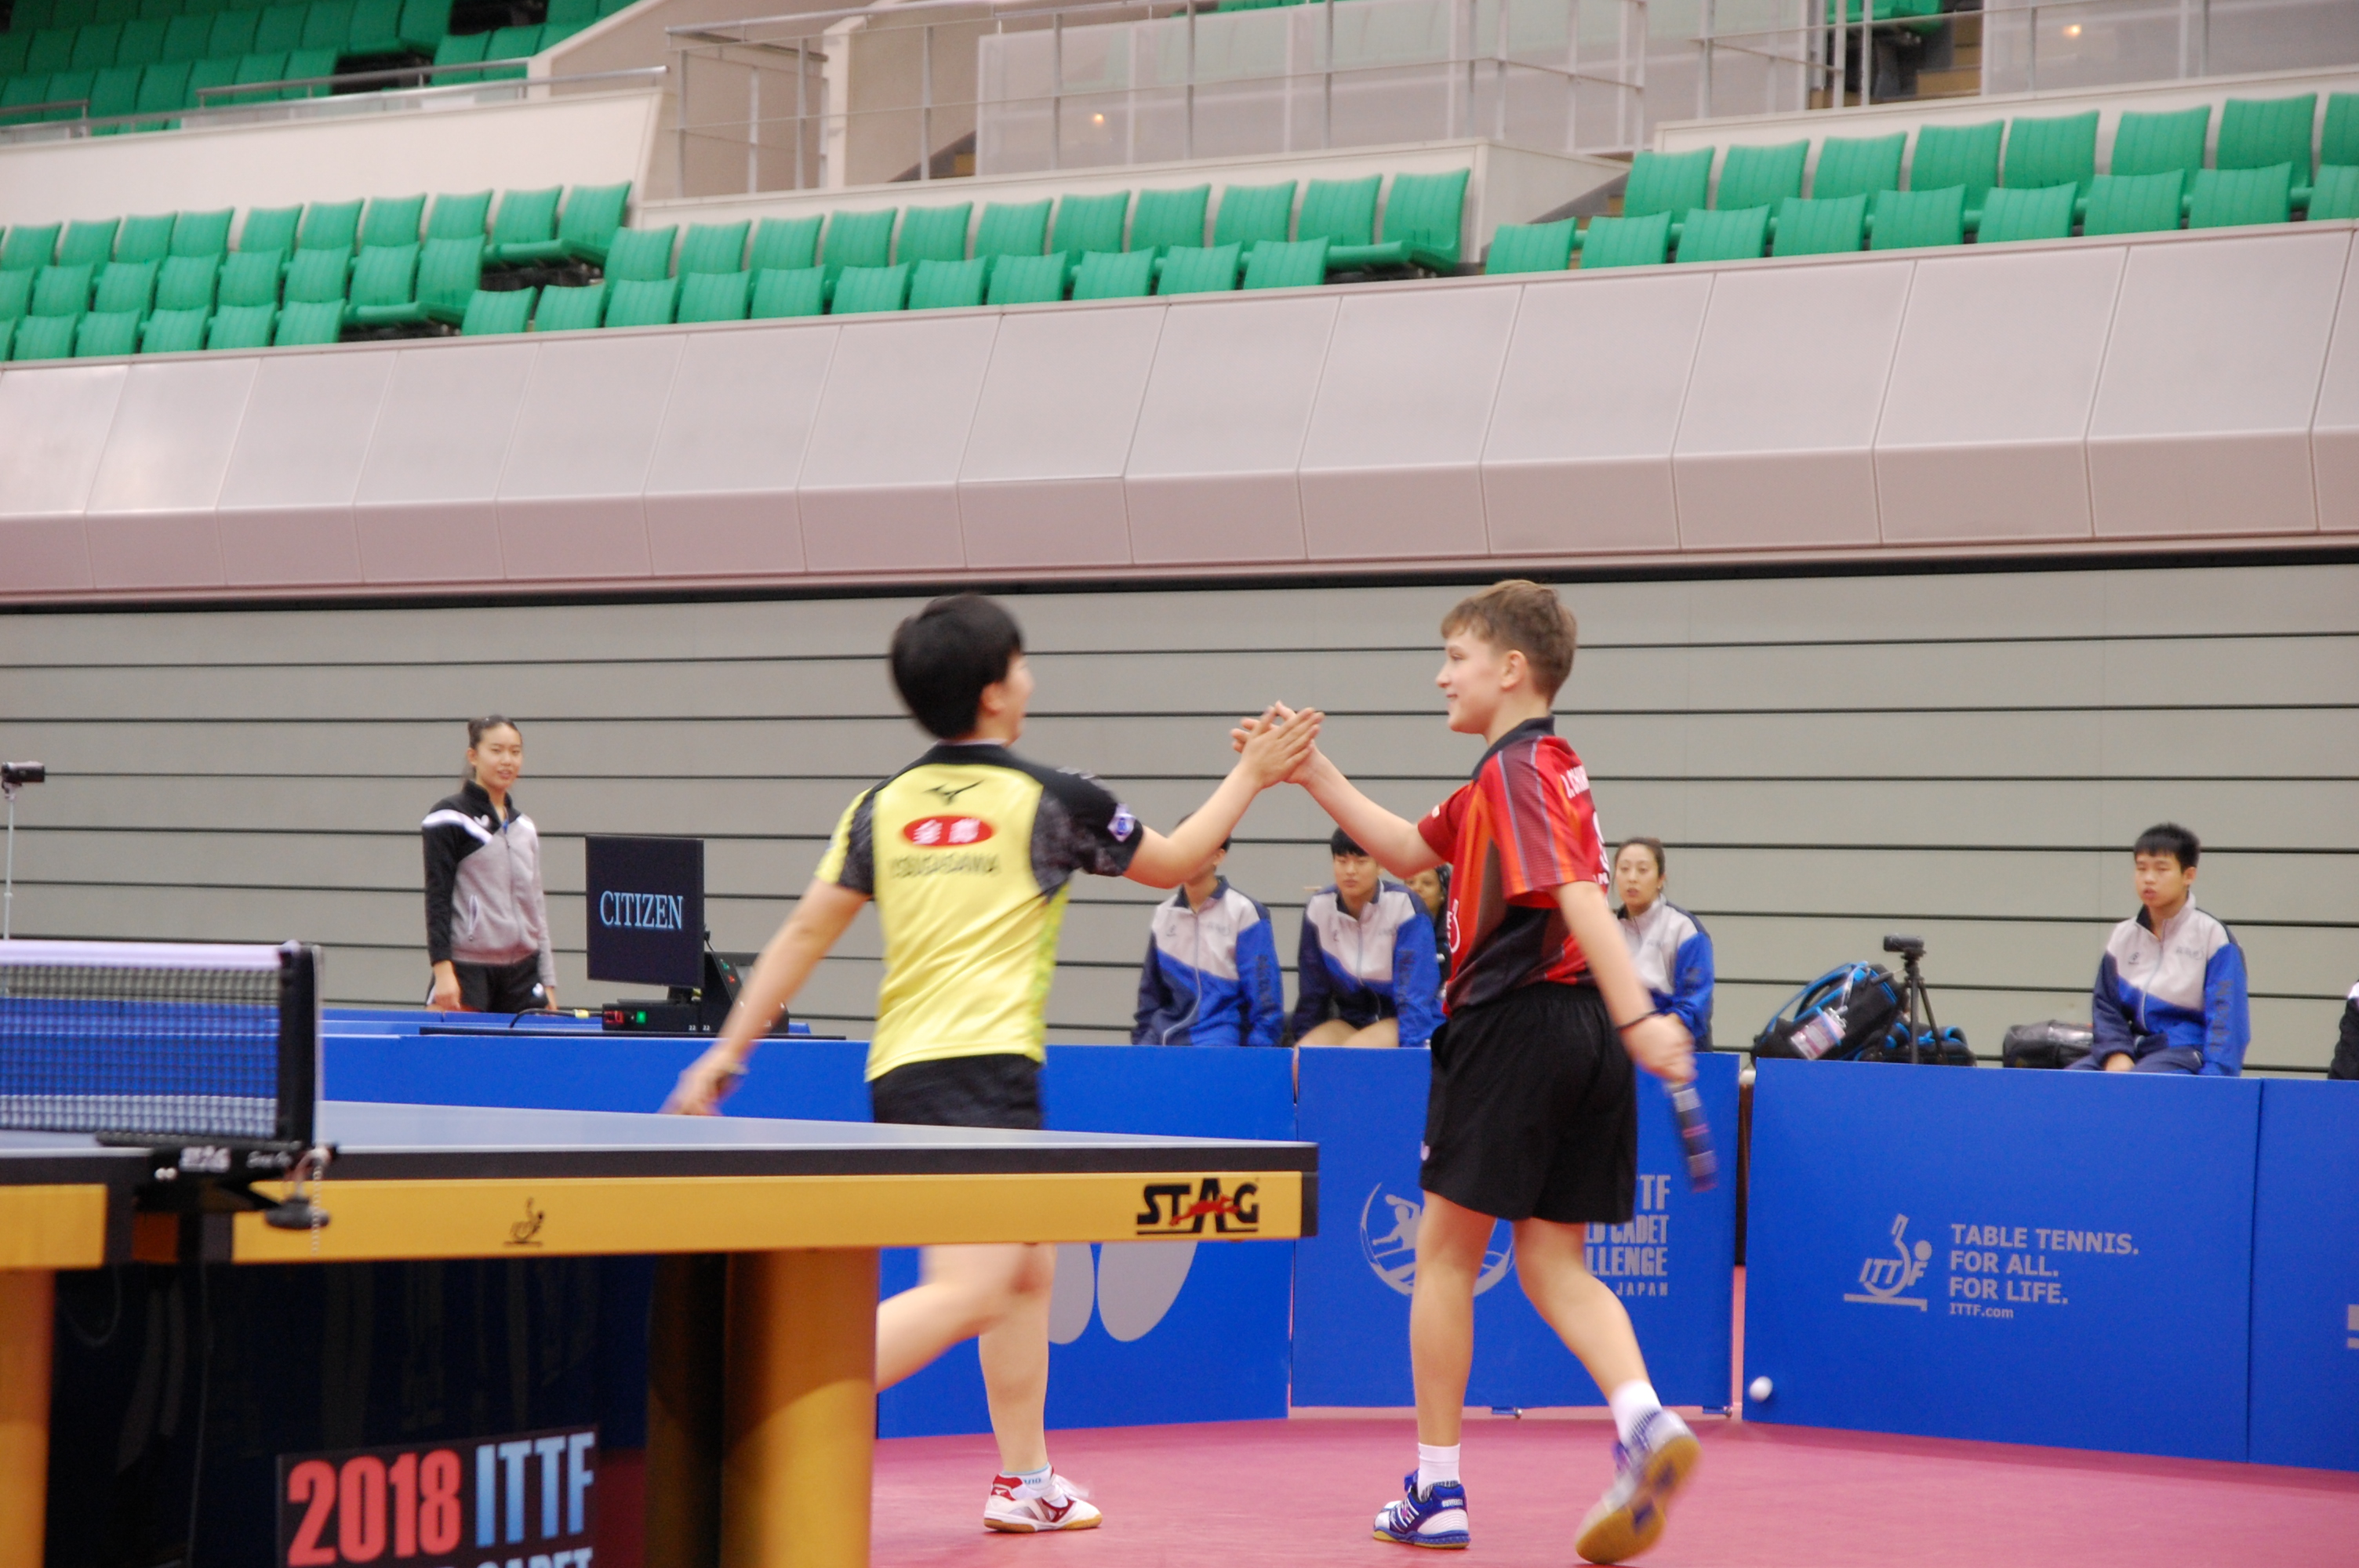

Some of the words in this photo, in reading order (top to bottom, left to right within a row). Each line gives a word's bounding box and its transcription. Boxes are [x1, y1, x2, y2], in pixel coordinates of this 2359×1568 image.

[600, 890, 684, 930] CITIZEN
[1136, 1178, 1259, 1234] STAG
[1638, 1174, 1672, 1210] TF
[1610, 1214, 1670, 1243] CADET
[1951, 1224, 2028, 1249] TABLE
[2035, 1229, 2139, 1255] TENNIS.
[1585, 1246, 1669, 1277] LLENGE
[1950, 1250, 1999, 1274] FOR
[2006, 1254, 2059, 1277] ALL.
[1616, 1281, 1669, 1297] JAPAN
[1949, 1277, 1999, 1301] FOR
[2006, 1279, 2069, 1305] LIFE.
[1949, 1302, 2014, 1319] ITTF.com
[287, 1448, 463, 1567] 2018
[475, 1431, 596, 1549] ITTF
